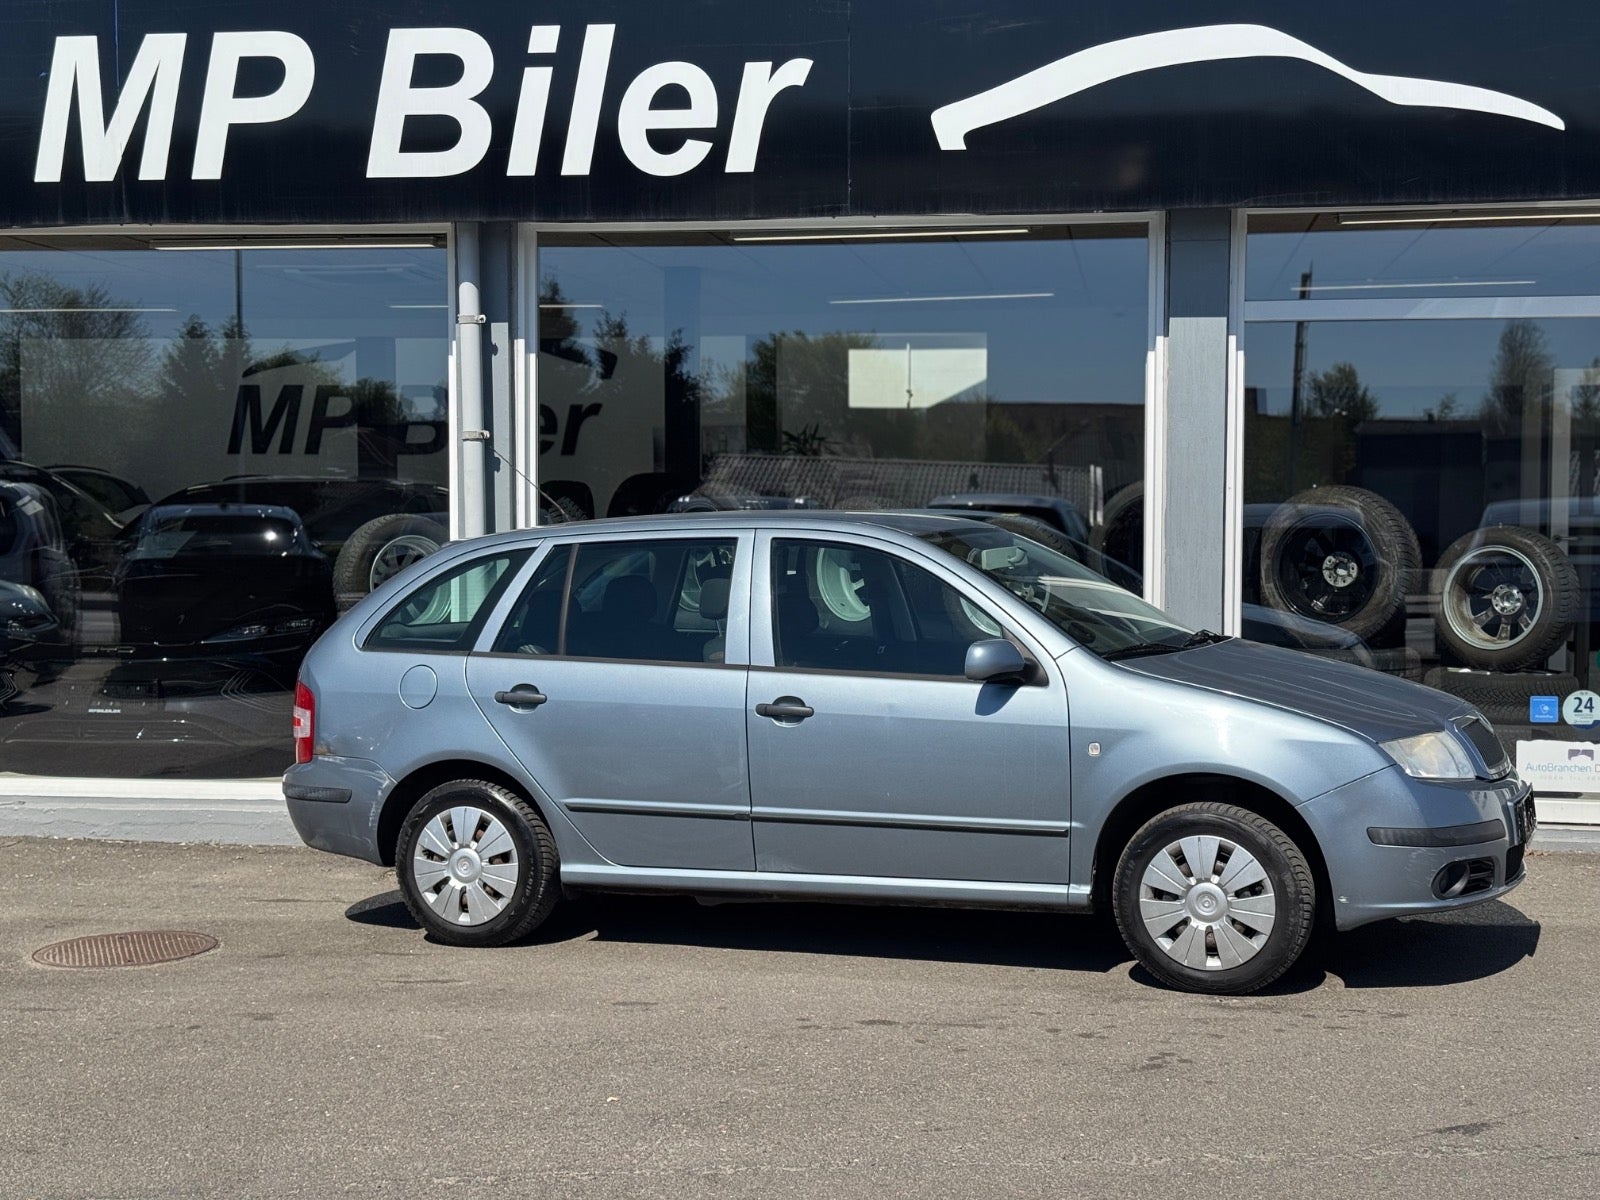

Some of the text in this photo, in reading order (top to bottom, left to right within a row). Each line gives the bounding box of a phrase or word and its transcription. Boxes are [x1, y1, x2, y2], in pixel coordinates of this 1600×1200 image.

[33, 23, 814, 183] MP Biler
[227, 384, 361, 456] MP
[1573, 696, 1594, 713] 24
[1525, 761, 1592, 773] AutoBranchen
